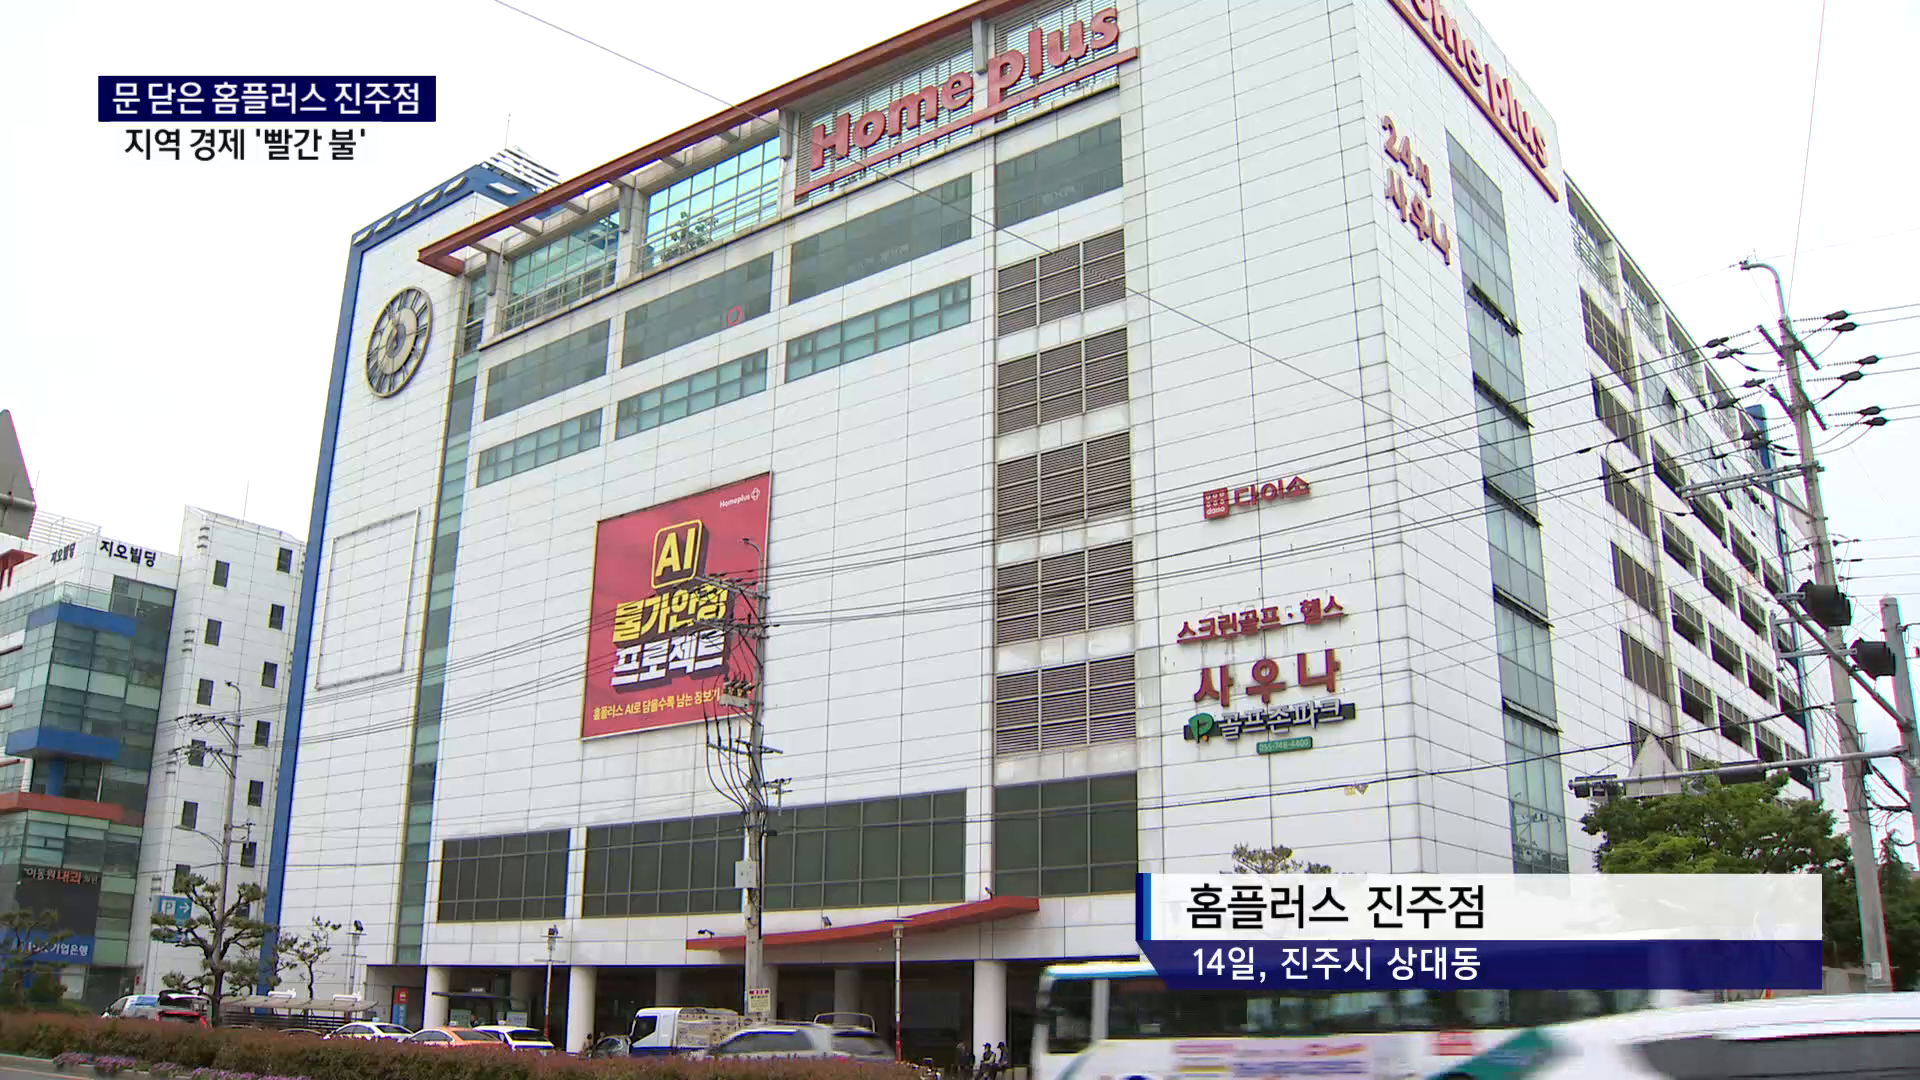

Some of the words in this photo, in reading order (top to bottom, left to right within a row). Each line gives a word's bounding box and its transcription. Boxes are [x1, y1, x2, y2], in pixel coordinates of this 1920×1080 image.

[810, 71, 974, 171] Home
[986, 8, 1120, 106] plus
[1382, 115, 1432, 198] 24시
[1384, 167, 1451, 266] 사우나
[1234, 476, 1312, 507] 다이소
[100, 540, 157, 568] 지오빌딩
[655, 527, 697, 577] AI
[612, 584, 730, 643] 물가안정
[610, 629, 725, 687] 프로젝트
[1193, 649, 1341, 708] 사우나
[593, 704, 624, 721] 홈플러스
[1218, 699, 1344, 741] 골프존파크
